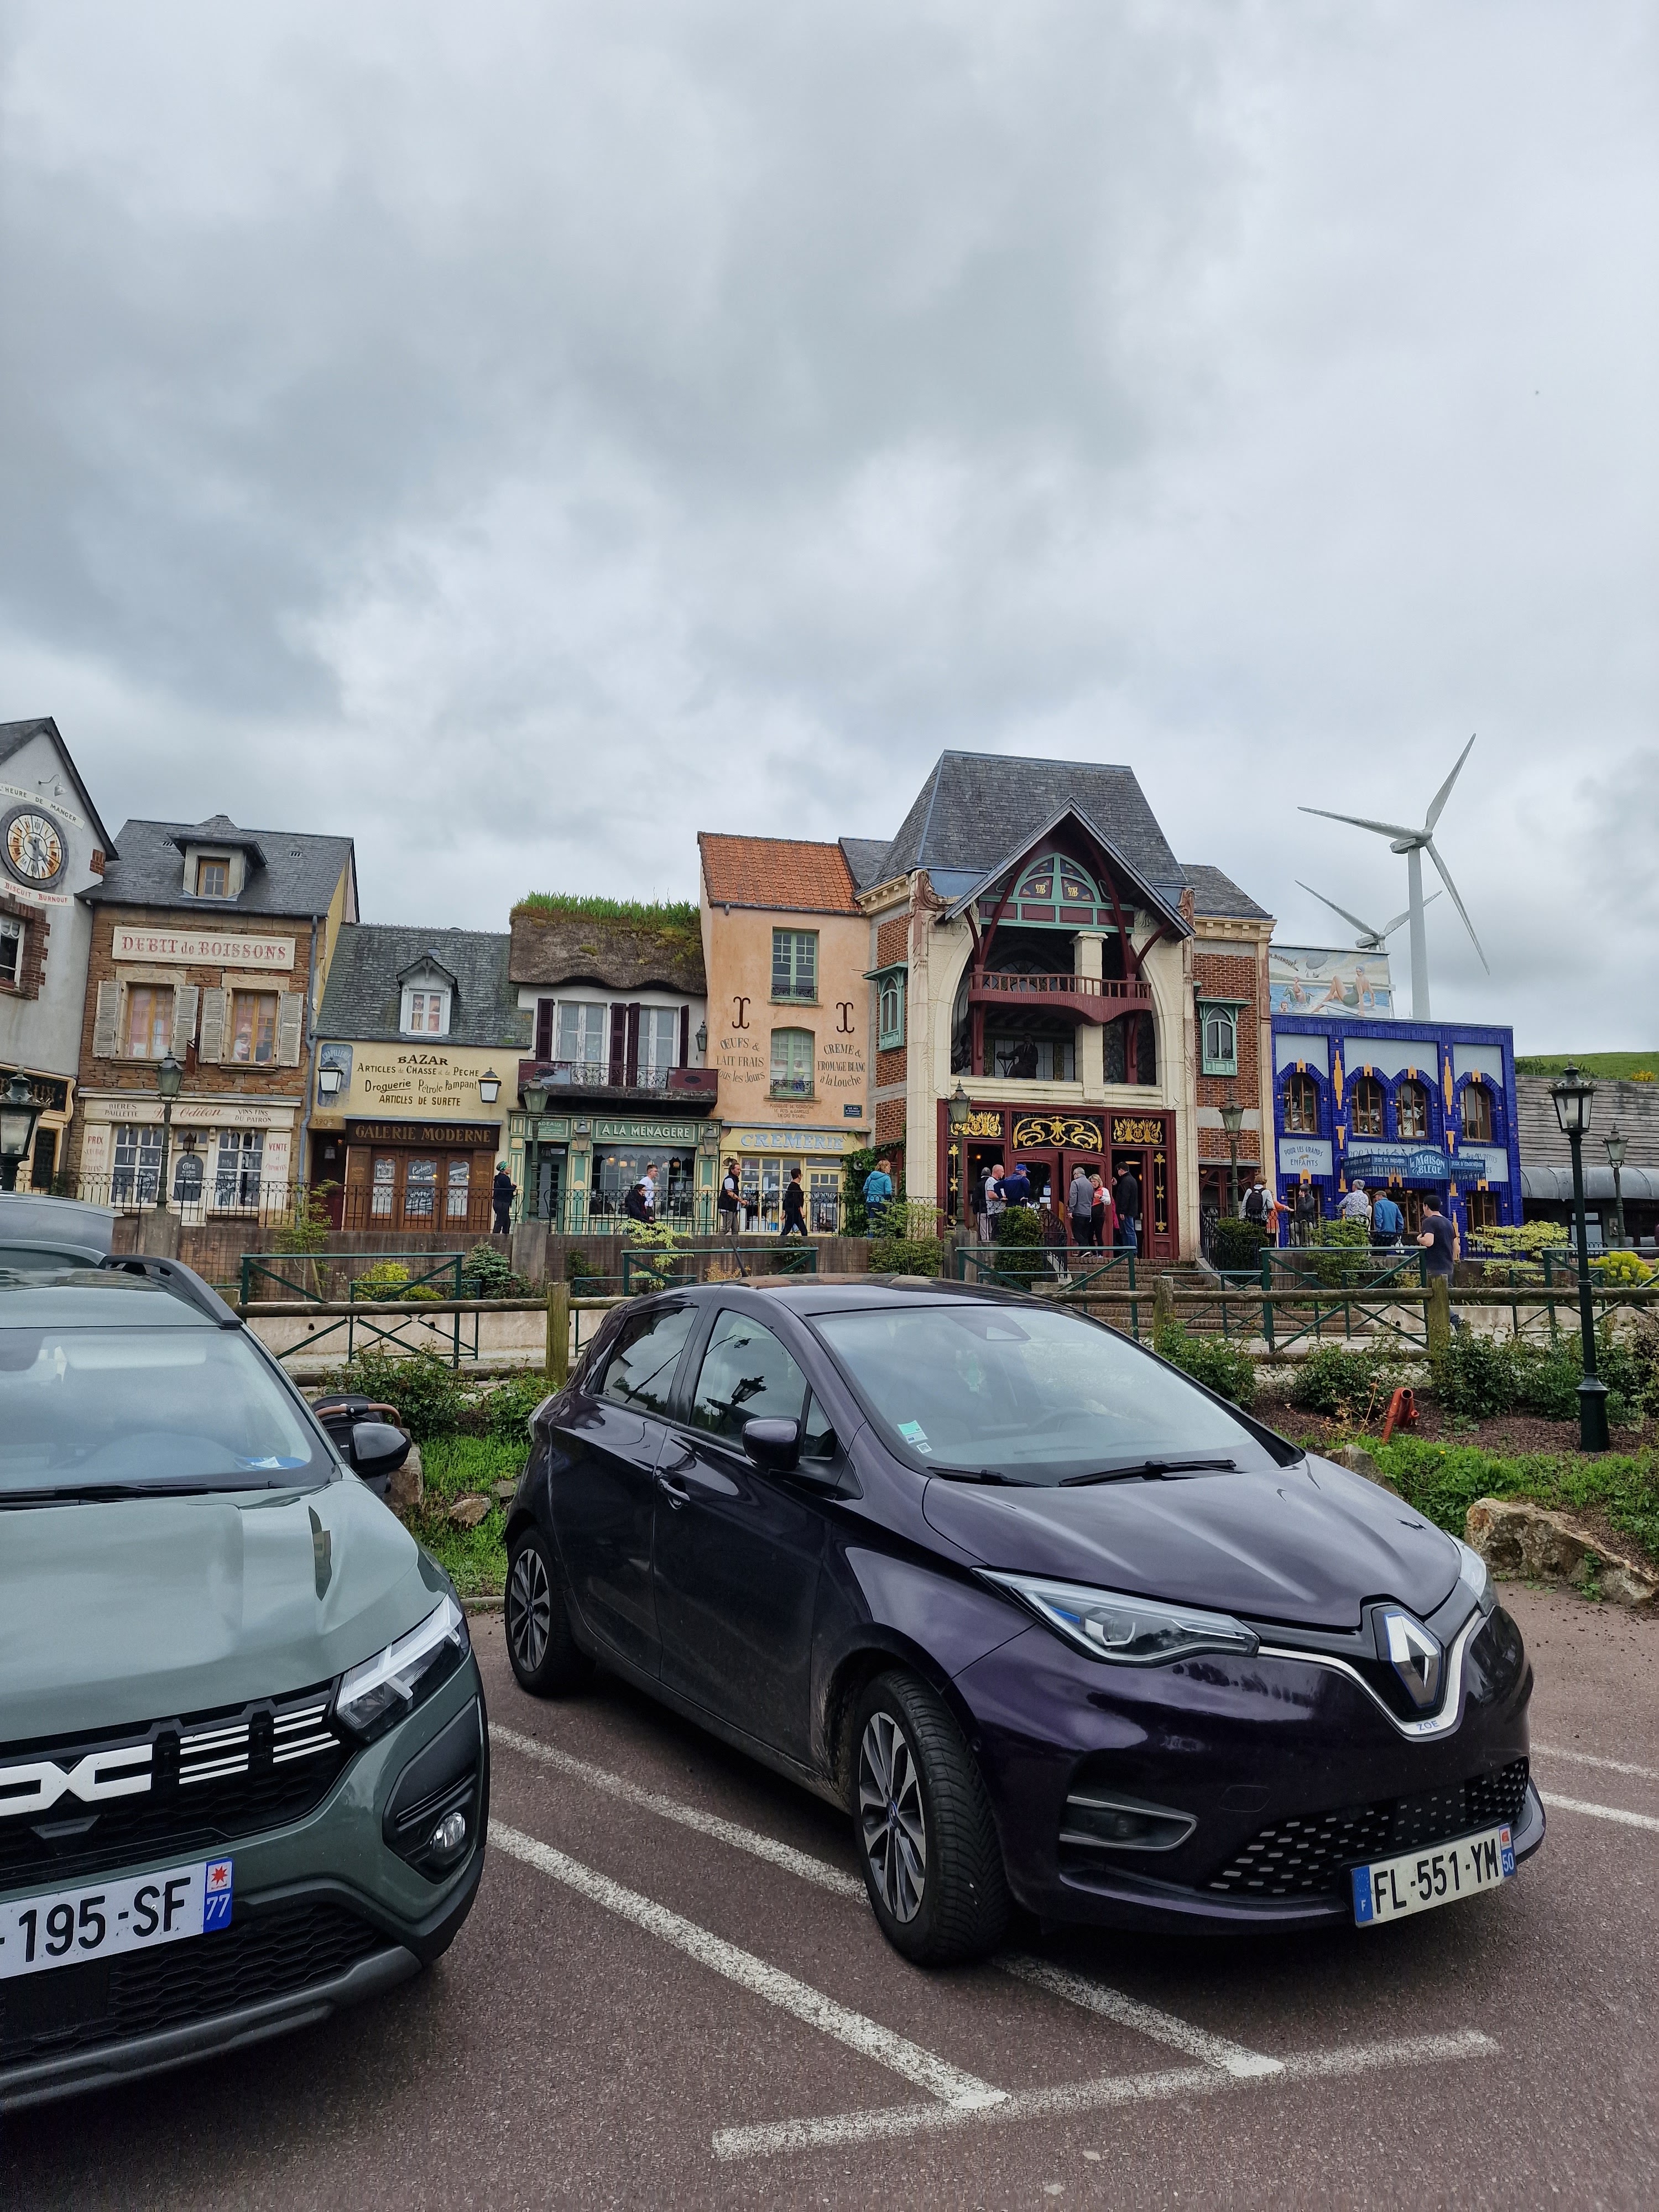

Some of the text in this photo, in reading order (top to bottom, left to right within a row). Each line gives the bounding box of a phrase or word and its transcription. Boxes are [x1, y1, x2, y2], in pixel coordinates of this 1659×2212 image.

[50, 804, 76, 822] MANGER
[4, 882, 68, 903] BISCUIT BURNOUF
[121, 936, 286, 961] DEBIT de BOISSONS
[752, 1042, 760, 1051] &
[823, 1044, 862, 1058] CREME &
[322, 1049, 351, 1060] CHAPELLERIE
[397, 1054, 448, 1066] BAZAR
[717, 1055, 764, 1067] LAIT FRAIS
[357, 1063, 396, 1073] ARTICLES
[406, 1065, 436, 1075] CHASSE
[452, 1067, 479, 1077] PECHE
[817, 1061, 865, 1072] FROMAGE BLANC
[733, 1071, 743, 1083] les
[745, 1071, 765, 1083] Jours
[825, 1073, 833, 1086] la
[833, 1074, 862, 1087] Louche
[365, 1079, 411, 1093] Droguerie
[379, 1095, 461, 1106] ARTICLES DE SURETE
[180, 1107, 223, 1118] Odilon
[355, 1125, 491, 1142] GALERIE MODERNE
[601, 1124, 690, 1139] A LA MENAGERE
[88, 1136, 103, 1144] PRIX
[269, 1143, 288, 1151] VENTE
[740, 1132, 844, 1150] CREMERIE
[1284, 1147, 1296, 1156] POUR
[1305, 1146, 1324, 1157] GRANDS
[1410, 1157, 1415, 1168] la
[1415, 1154, 1445, 1169] MAISON
[1412, 1165, 1442, 1176] BLEUE
[1416, 1720, 1440, 1731] ZOE
[1503, 1852, 1515, 1872] 50
[1374, 1838, 1499, 1914] FL-551-YM
[205, 1893, 231, 1921] 77
[1361, 1898, 1366, 1912] F
